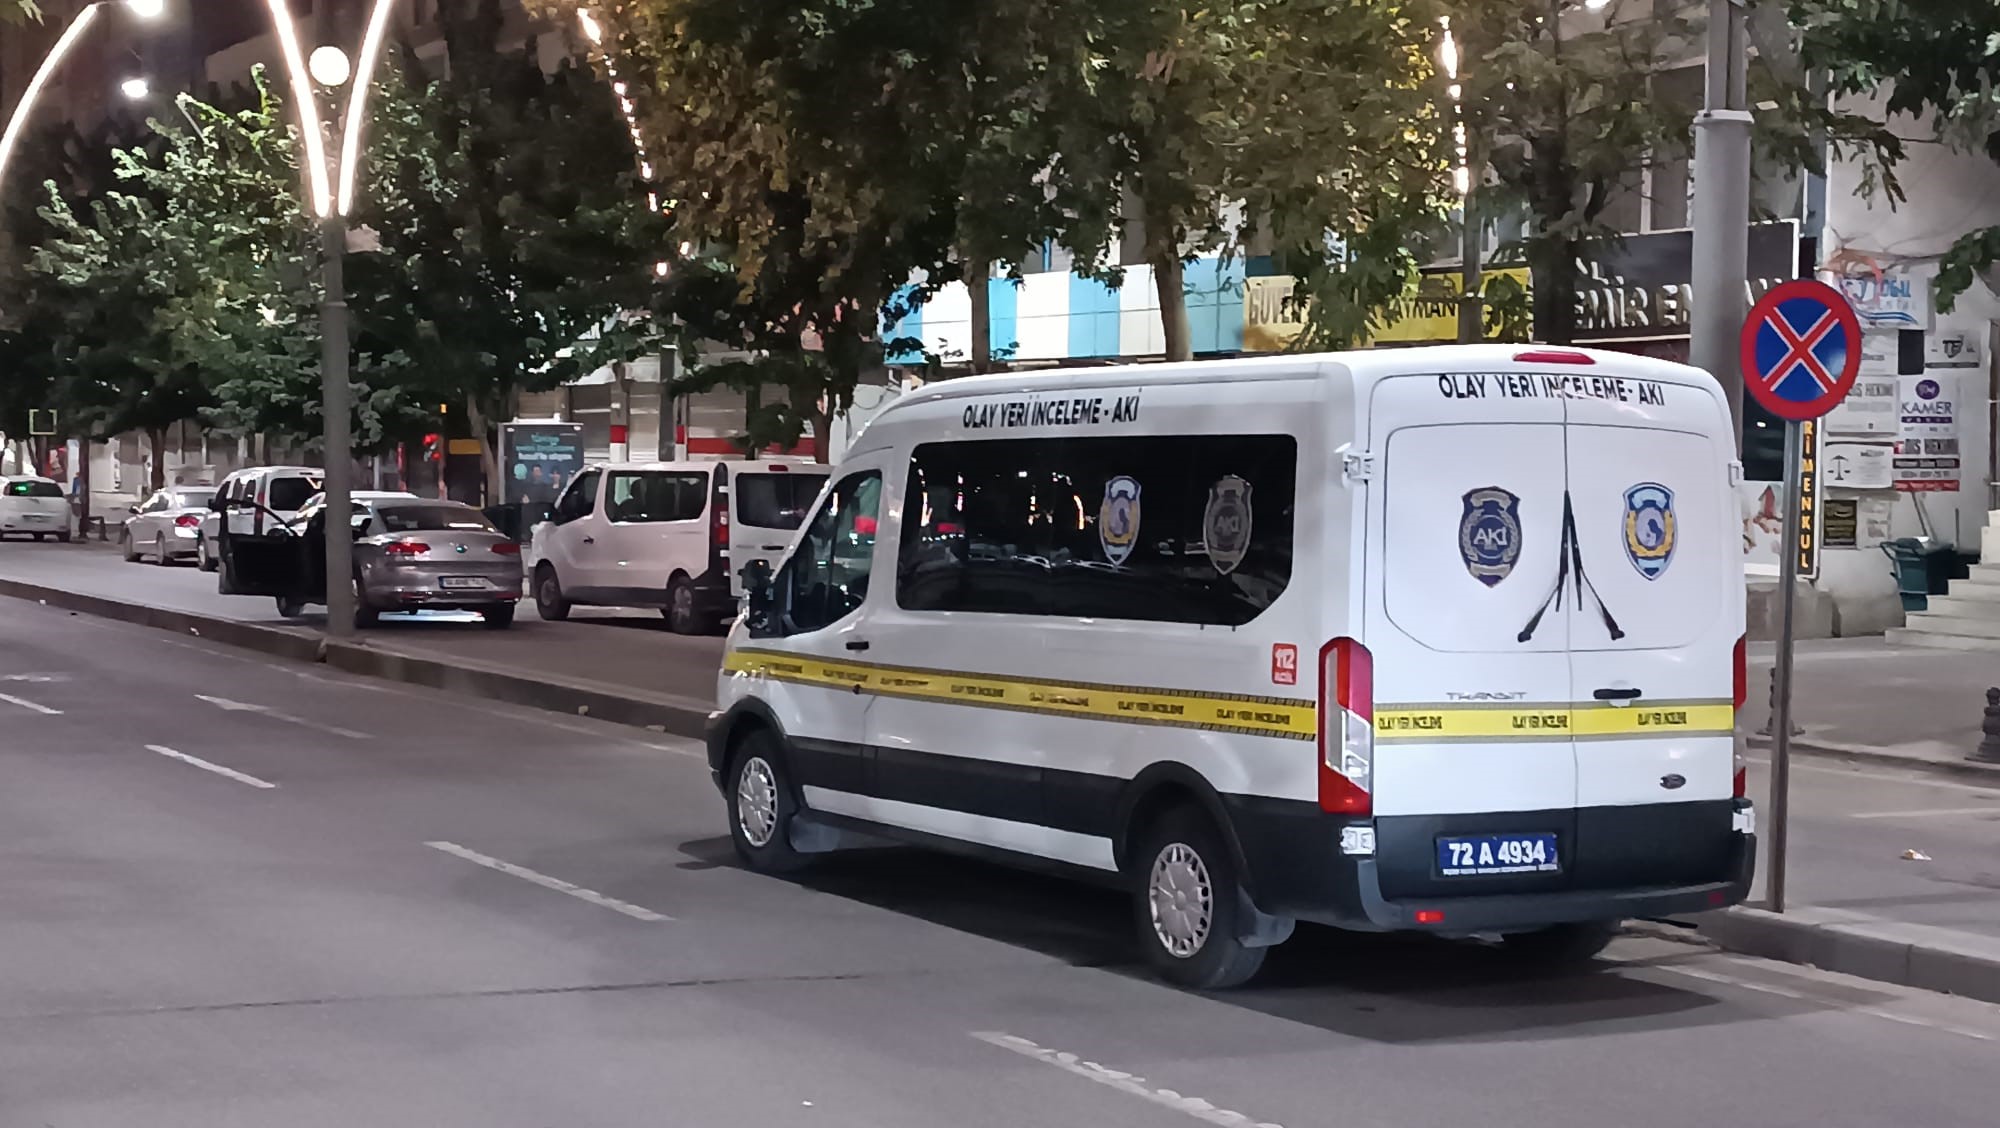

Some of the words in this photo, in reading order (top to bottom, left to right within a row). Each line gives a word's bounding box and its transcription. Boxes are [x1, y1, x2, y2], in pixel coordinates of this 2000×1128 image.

[1438, 373, 1485, 398] OLAY
[962, 404, 998, 428] OLAY
[1901, 401, 1952, 415] KAMER
[1800, 420, 1814, 568] RİMENKUL
[1275, 648, 1295, 669] 112
[1448, 841, 1475, 866] 72
[1478, 841, 1494, 865] A
[1498, 839, 1546, 865] 4934
